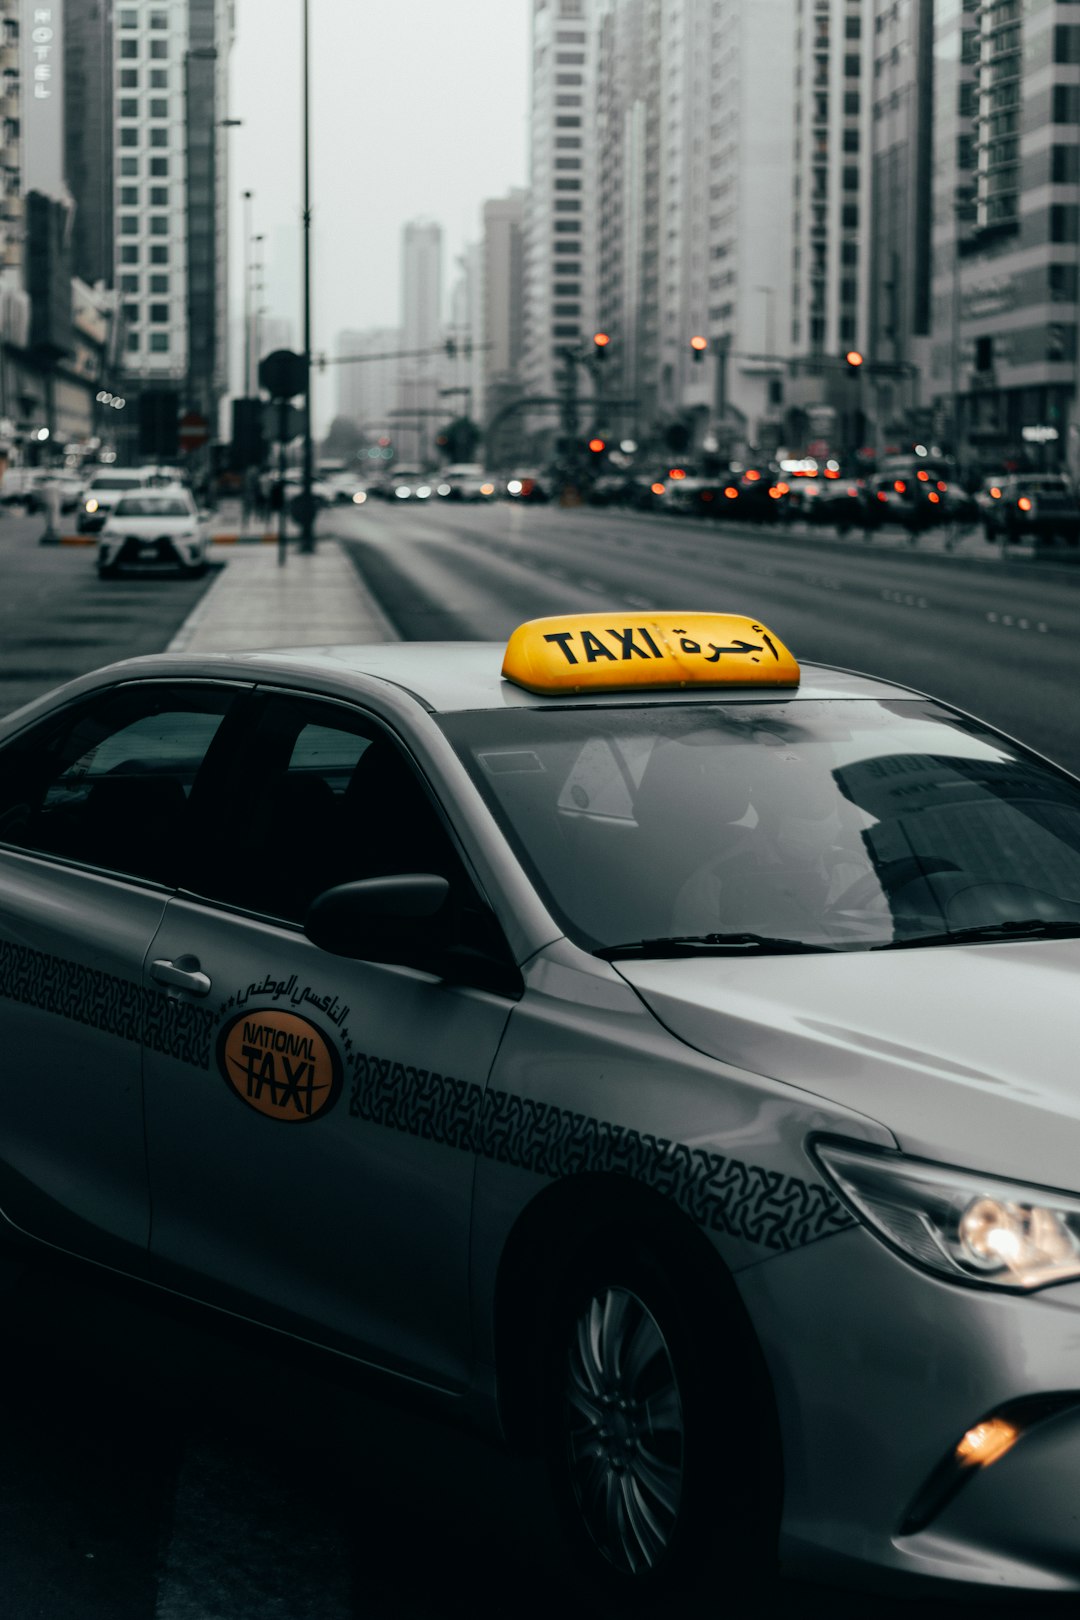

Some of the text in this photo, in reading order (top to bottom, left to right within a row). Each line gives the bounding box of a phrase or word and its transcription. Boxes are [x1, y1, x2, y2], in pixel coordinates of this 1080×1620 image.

[31, 8, 53, 99] HOTEL
[543, 627, 664, 664] TAXI
[672, 624, 780, 662] أجرة
[236, 974, 298, 1007] الوطني
[243, 1021, 316, 1062] NATIONAL
[242, 1044, 315, 1115] TAXI
